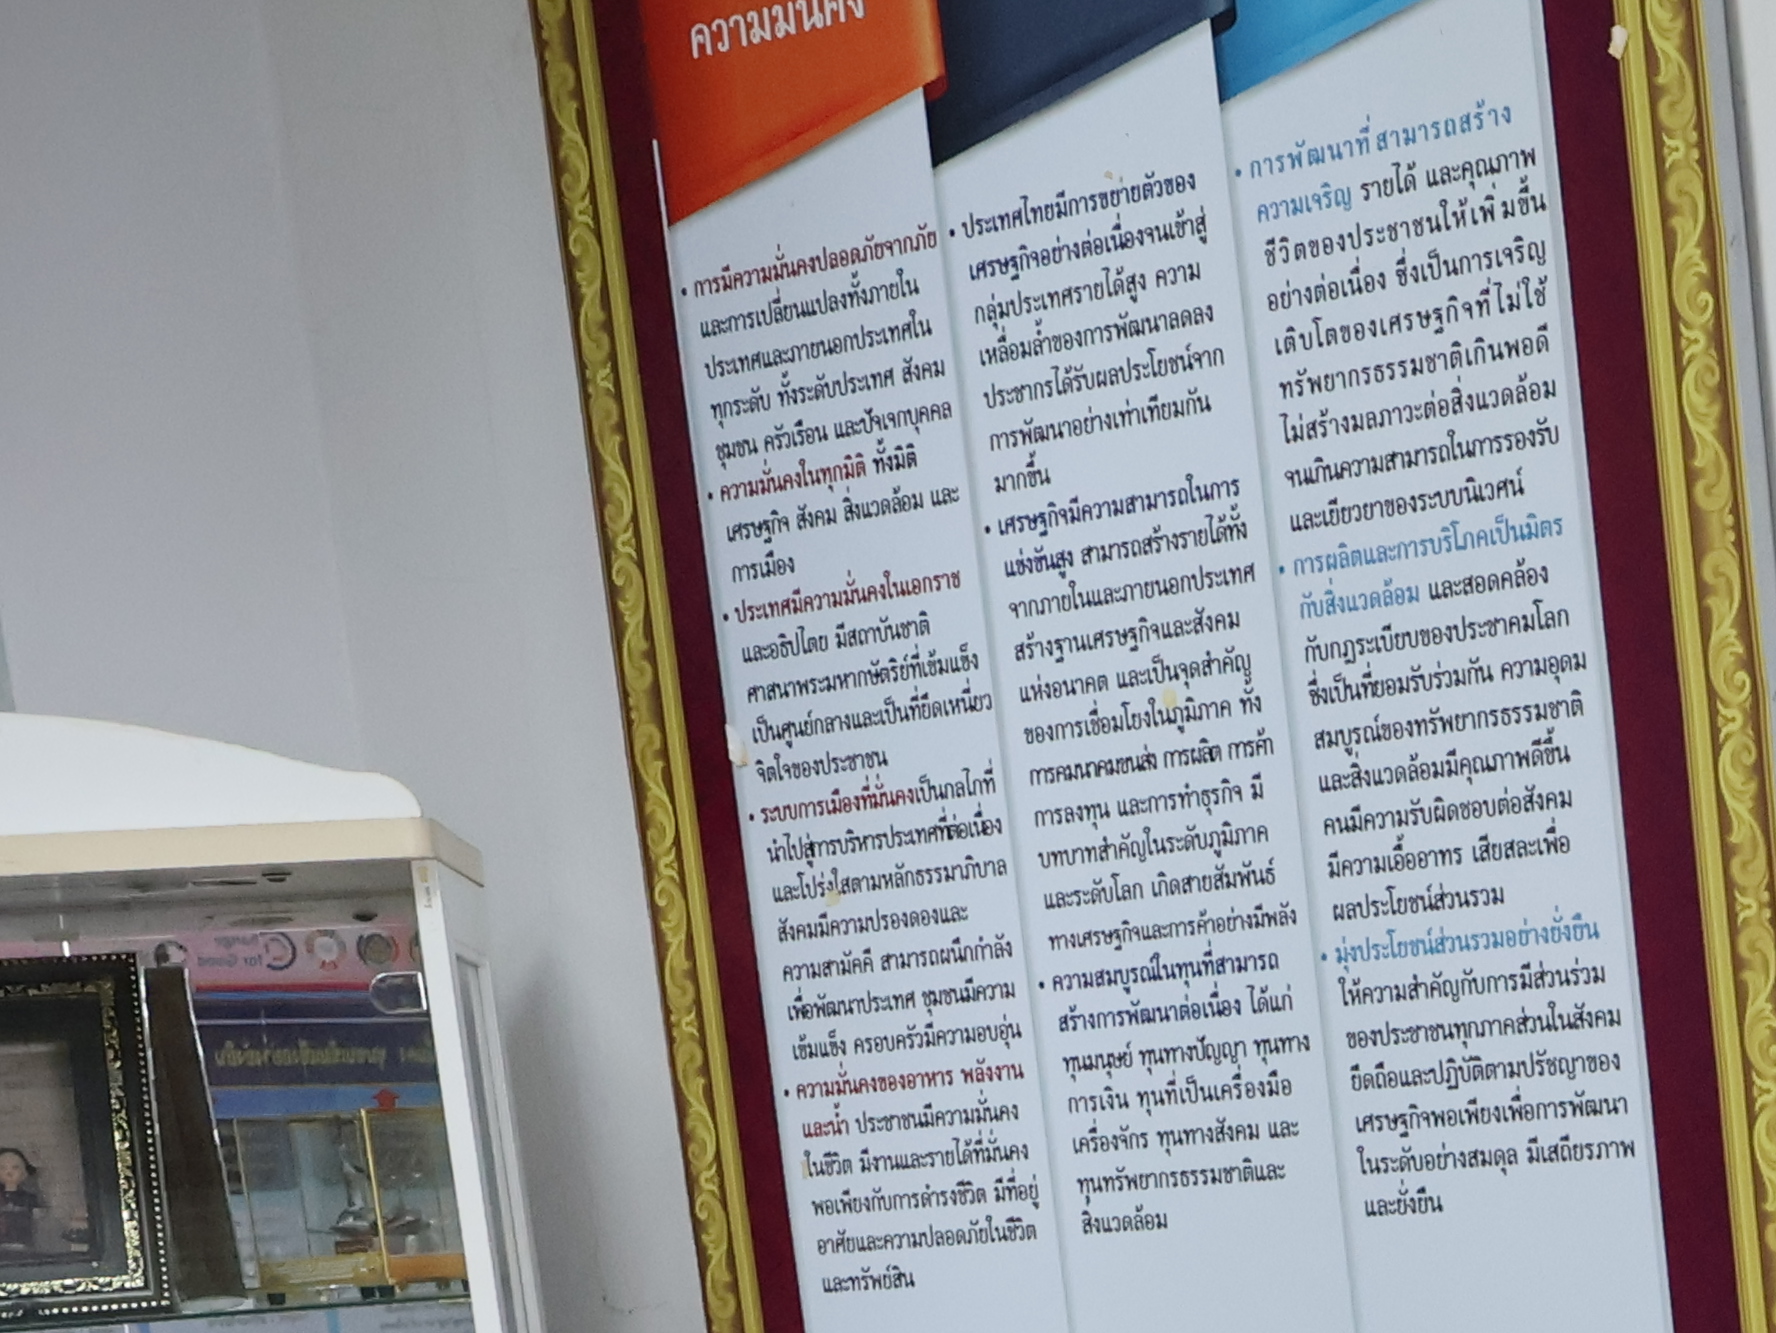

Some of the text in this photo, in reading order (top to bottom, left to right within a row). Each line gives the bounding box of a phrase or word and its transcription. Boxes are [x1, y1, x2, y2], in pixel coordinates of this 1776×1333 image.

[1257, 147, 1537, 224] ความเจริญ รายได้ และคุณภาพ
[974, 261, 1202, 331] กลุ่มประเทศรายได้สูง ความ
[1266, 234, 1547, 312] อย่างต่อเนื่อง ซึ่งเป็นการเจริญ
[709, 355, 946, 430] ทุกระดับ ทั้งระดับประเทศ สังคม
[714, 400, 953, 471] ชุมชน ครัวเรือน และปัจเจกบุคคล
[719, 437, 918, 503] ความมั่นคงในทุกมิติ ทั้งมิติ
[993, 449, 1052, 494] มากขึ้น
[726, 485, 961, 545] เศรษฐกิจ สังคม สิ่งแวดล้อม และ
[731, 549, 796, 584] การเมือง
[1003, 544, 1075, 580] แข่งขันสูง
[1299, 556, 1550, 620] กับสิ่งแวดล้อม และสอดคล้อง
[834, 609, 931, 650] มีสถาบันชาติ
[1018, 644, 1253, 704] แห่งอนาคต และเป็นจุดสำคัญ
[1500, 651, 1588, 685] ความอุดม
[1238, 686, 1263, 716] ทั้ง
[754, 750, 889, 784] จิตใจของประชาชน
[1029, 726, 1275, 787] การคมนาคมขนส่ง การผลิต การค้า
[1033, 771, 1264, 831] การลงทุน และการทำธุรกิจ มี
[1326, 816, 1571, 880] มีความเอื้ออาทร เสียสละเพื่อ
[1043, 856, 1276, 911] และระดับโลก เกิดสายสัมพันธ์
[1332, 881, 1505, 922] ผลประโยชน์ส่วนรวม
[782, 932, 1013, 983] ความสามัคคี สามารถผนึกกำลัง
[786, 975, 1017, 1022] เพื่อพัฒนาประเทศ ชุมชนมีความ
[1246, 983, 1294, 1015] ได้แก่
[791, 1013, 1023, 1061] เข้มแข็ง ครอบครัวมีความอบอุ่น
[1061, 1034, 1311, 1083] ทุนมนุษย์ ทุนทางปัญญา ทุนทาง
[795, 1057, 1025, 1100] ความมั่นคงของอาหาร พลังงาน
[1067, 1063, 1293, 1117] การเงิน ทุนที่เป็นเครื่องมือ
[801, 1088, 1020, 1139] และน้ำ ประชาชนมีความมั่นคง
[1072, 1116, 1300, 1158] เครื่องจักร ทุนทางสังคม และ
[802, 1149, 854, 1179] ในชีวิต
[1355, 1133, 1636, 1186] ในระดับอย่างสมดุล มีเสถียรภาพ
[993, 1167, 1040, 1211] มีที่อยู่
[1363, 1185, 1445, 1218] และยั่งยืน
[821, 1263, 916, 1294] และทรัพย์สิน
